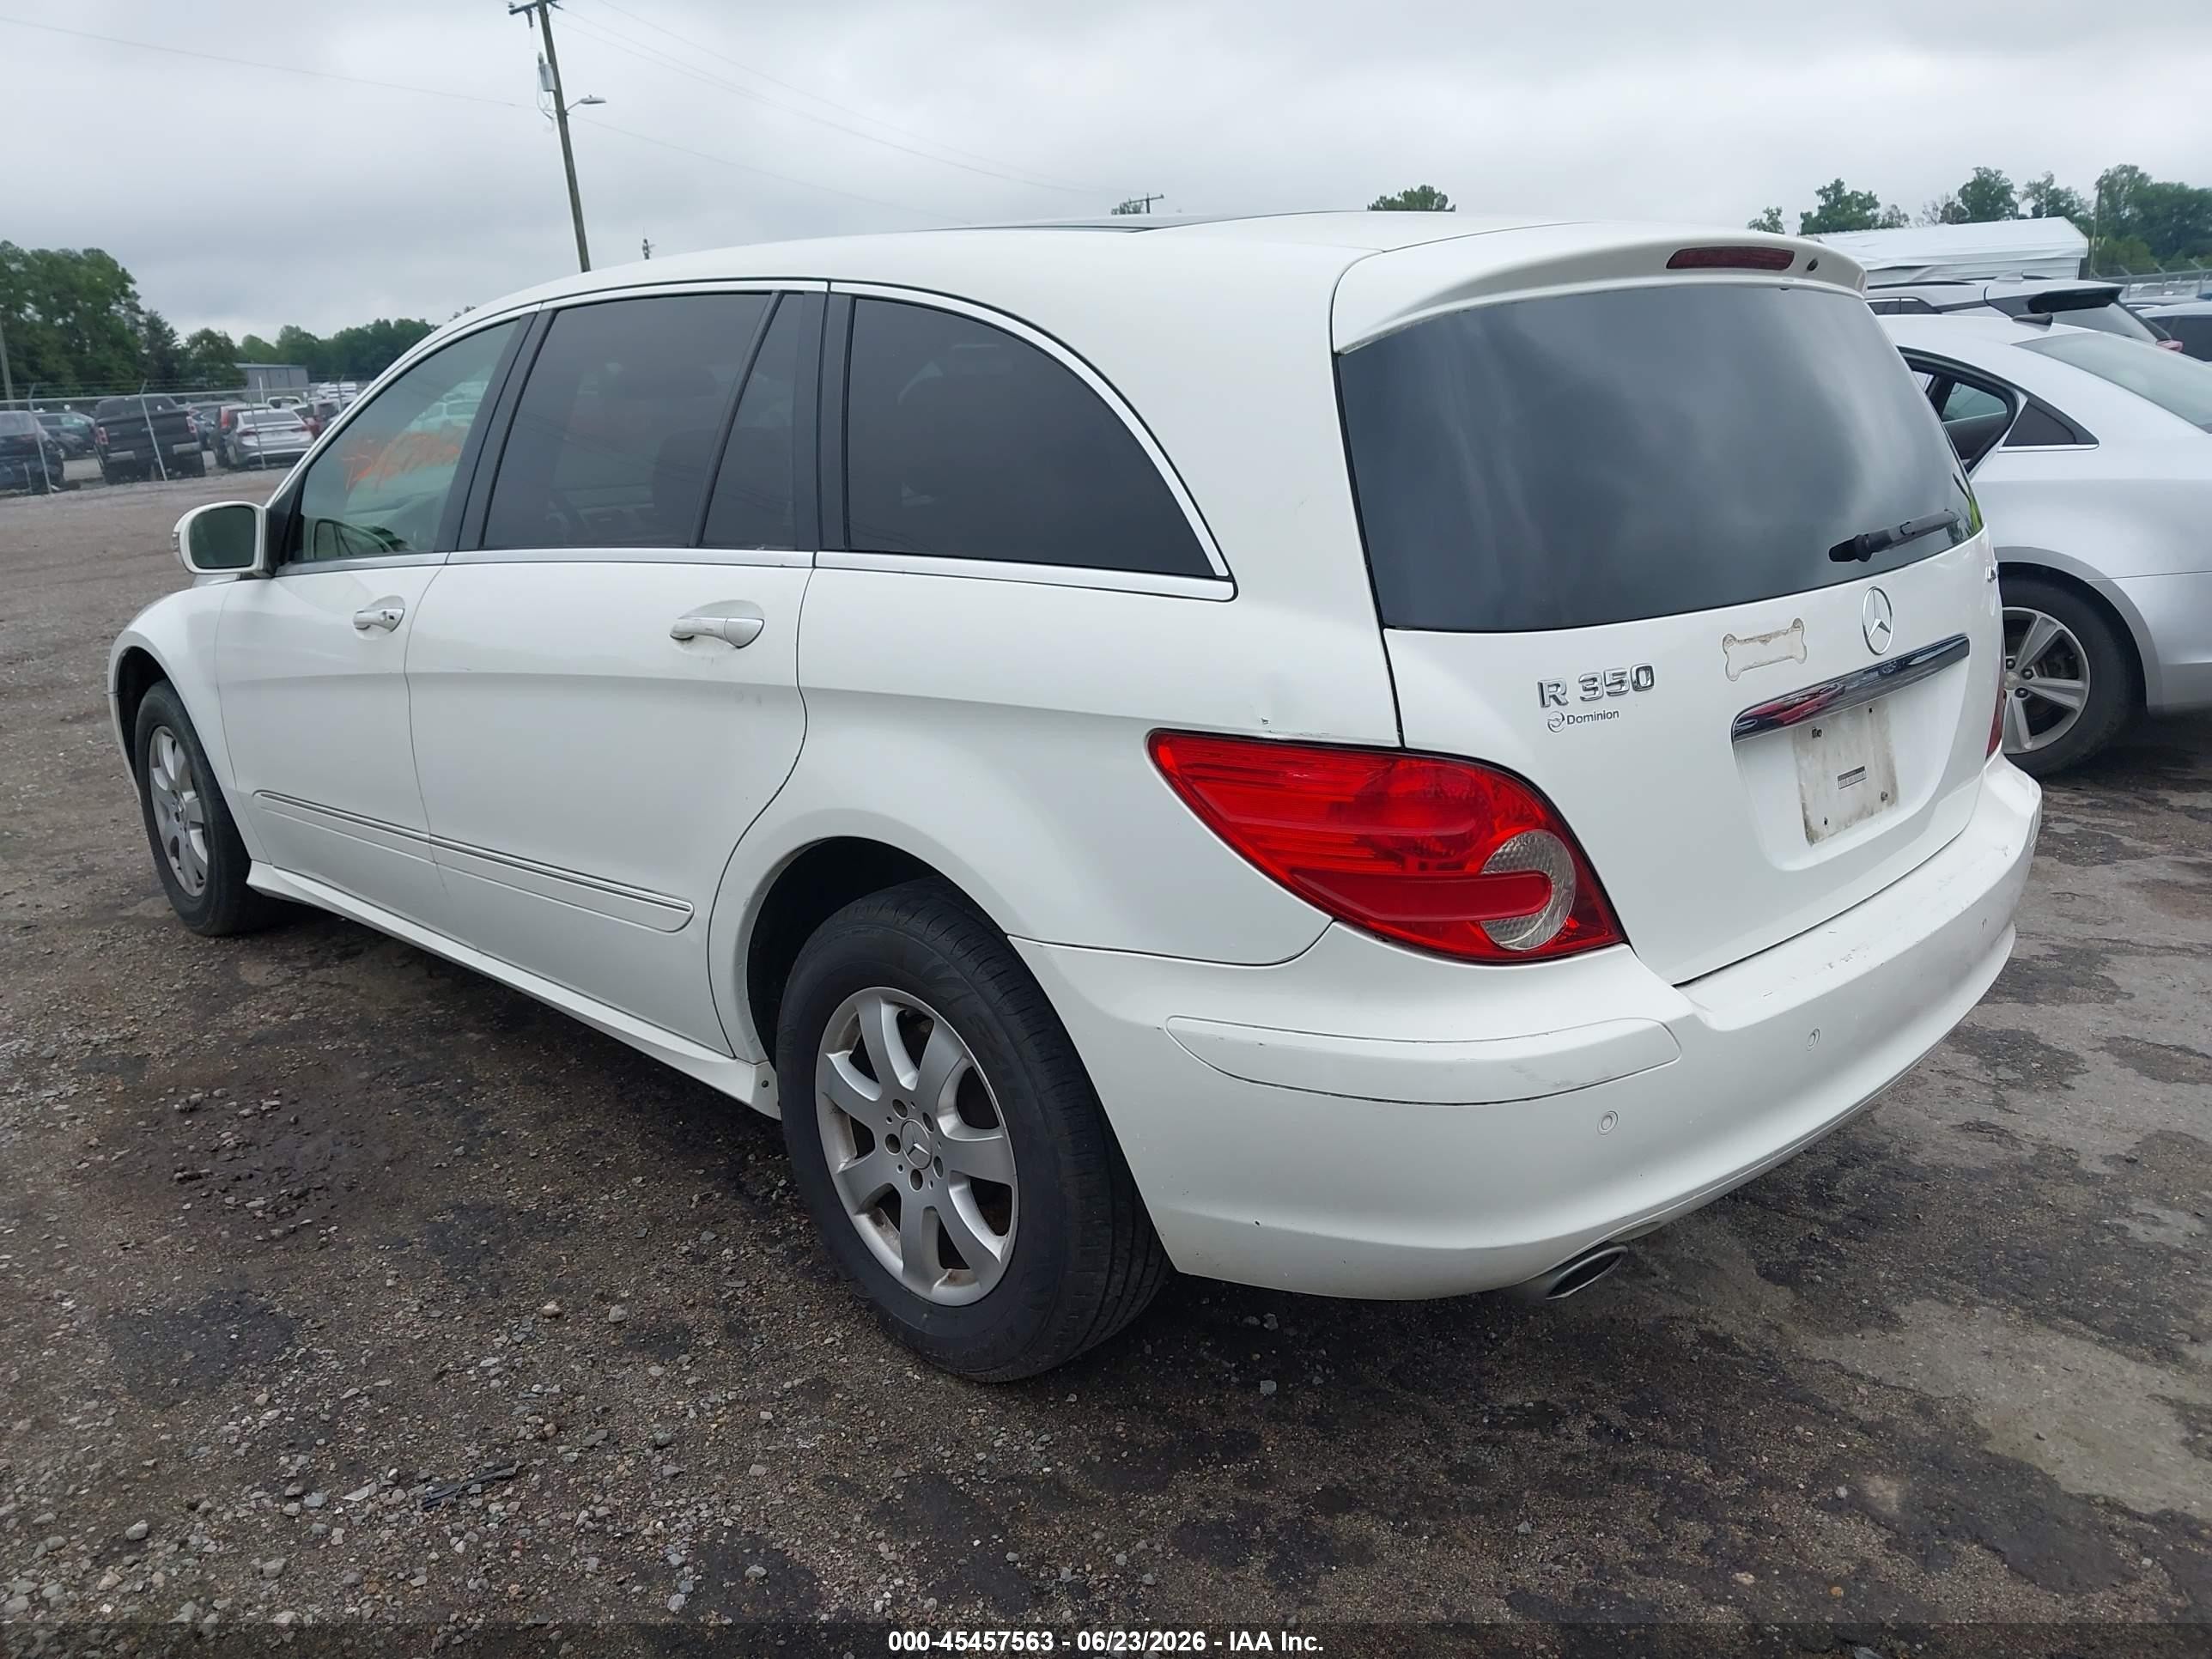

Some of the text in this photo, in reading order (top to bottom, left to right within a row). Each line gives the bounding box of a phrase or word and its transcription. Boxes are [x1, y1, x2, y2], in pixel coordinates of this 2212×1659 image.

[1538, 663, 1655, 708] R 350
[1566, 710, 1620, 725] Dominion
